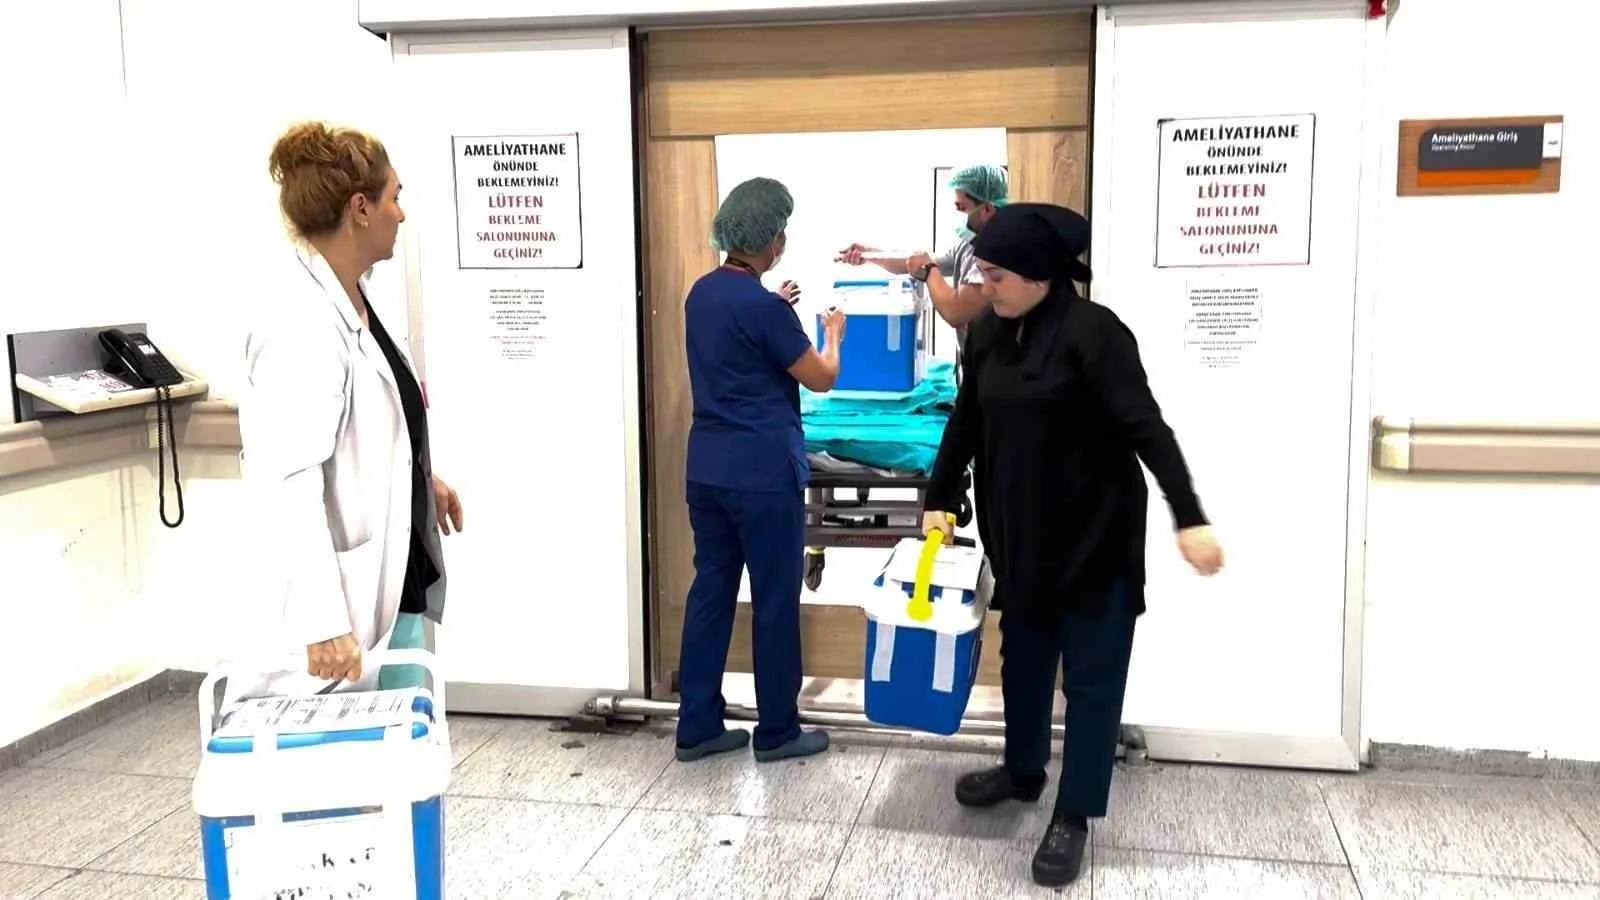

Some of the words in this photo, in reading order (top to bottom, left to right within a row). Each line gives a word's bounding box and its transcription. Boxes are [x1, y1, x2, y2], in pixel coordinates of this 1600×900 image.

[1173, 124, 1300, 142] AMELİYATHANE
[1431, 131, 1495, 147] Ameliyathane
[1496, 131, 1518, 144] Giriş
[464, 141, 566, 156] AMELİYATHANE
[1207, 145, 1263, 158] ÖNÜNDE
[493, 160, 539, 171] ÖNÜNDE
[1186, 161, 1287, 176] BEKLEMEYİNİZ!
[477, 175, 559, 187] BEKLEMEYİNİZ!
[1198, 182, 1266, 199] LÜTFEN
[488, 193, 544, 208] LÜTFEN
[488, 215, 542, 224] BEKLEME
[476, 231, 556, 241] SALONUNUNA
[493, 248, 542, 260] GEÇİNİZ!
[1199, 241, 1260, 256] GEÇİNİZ!
